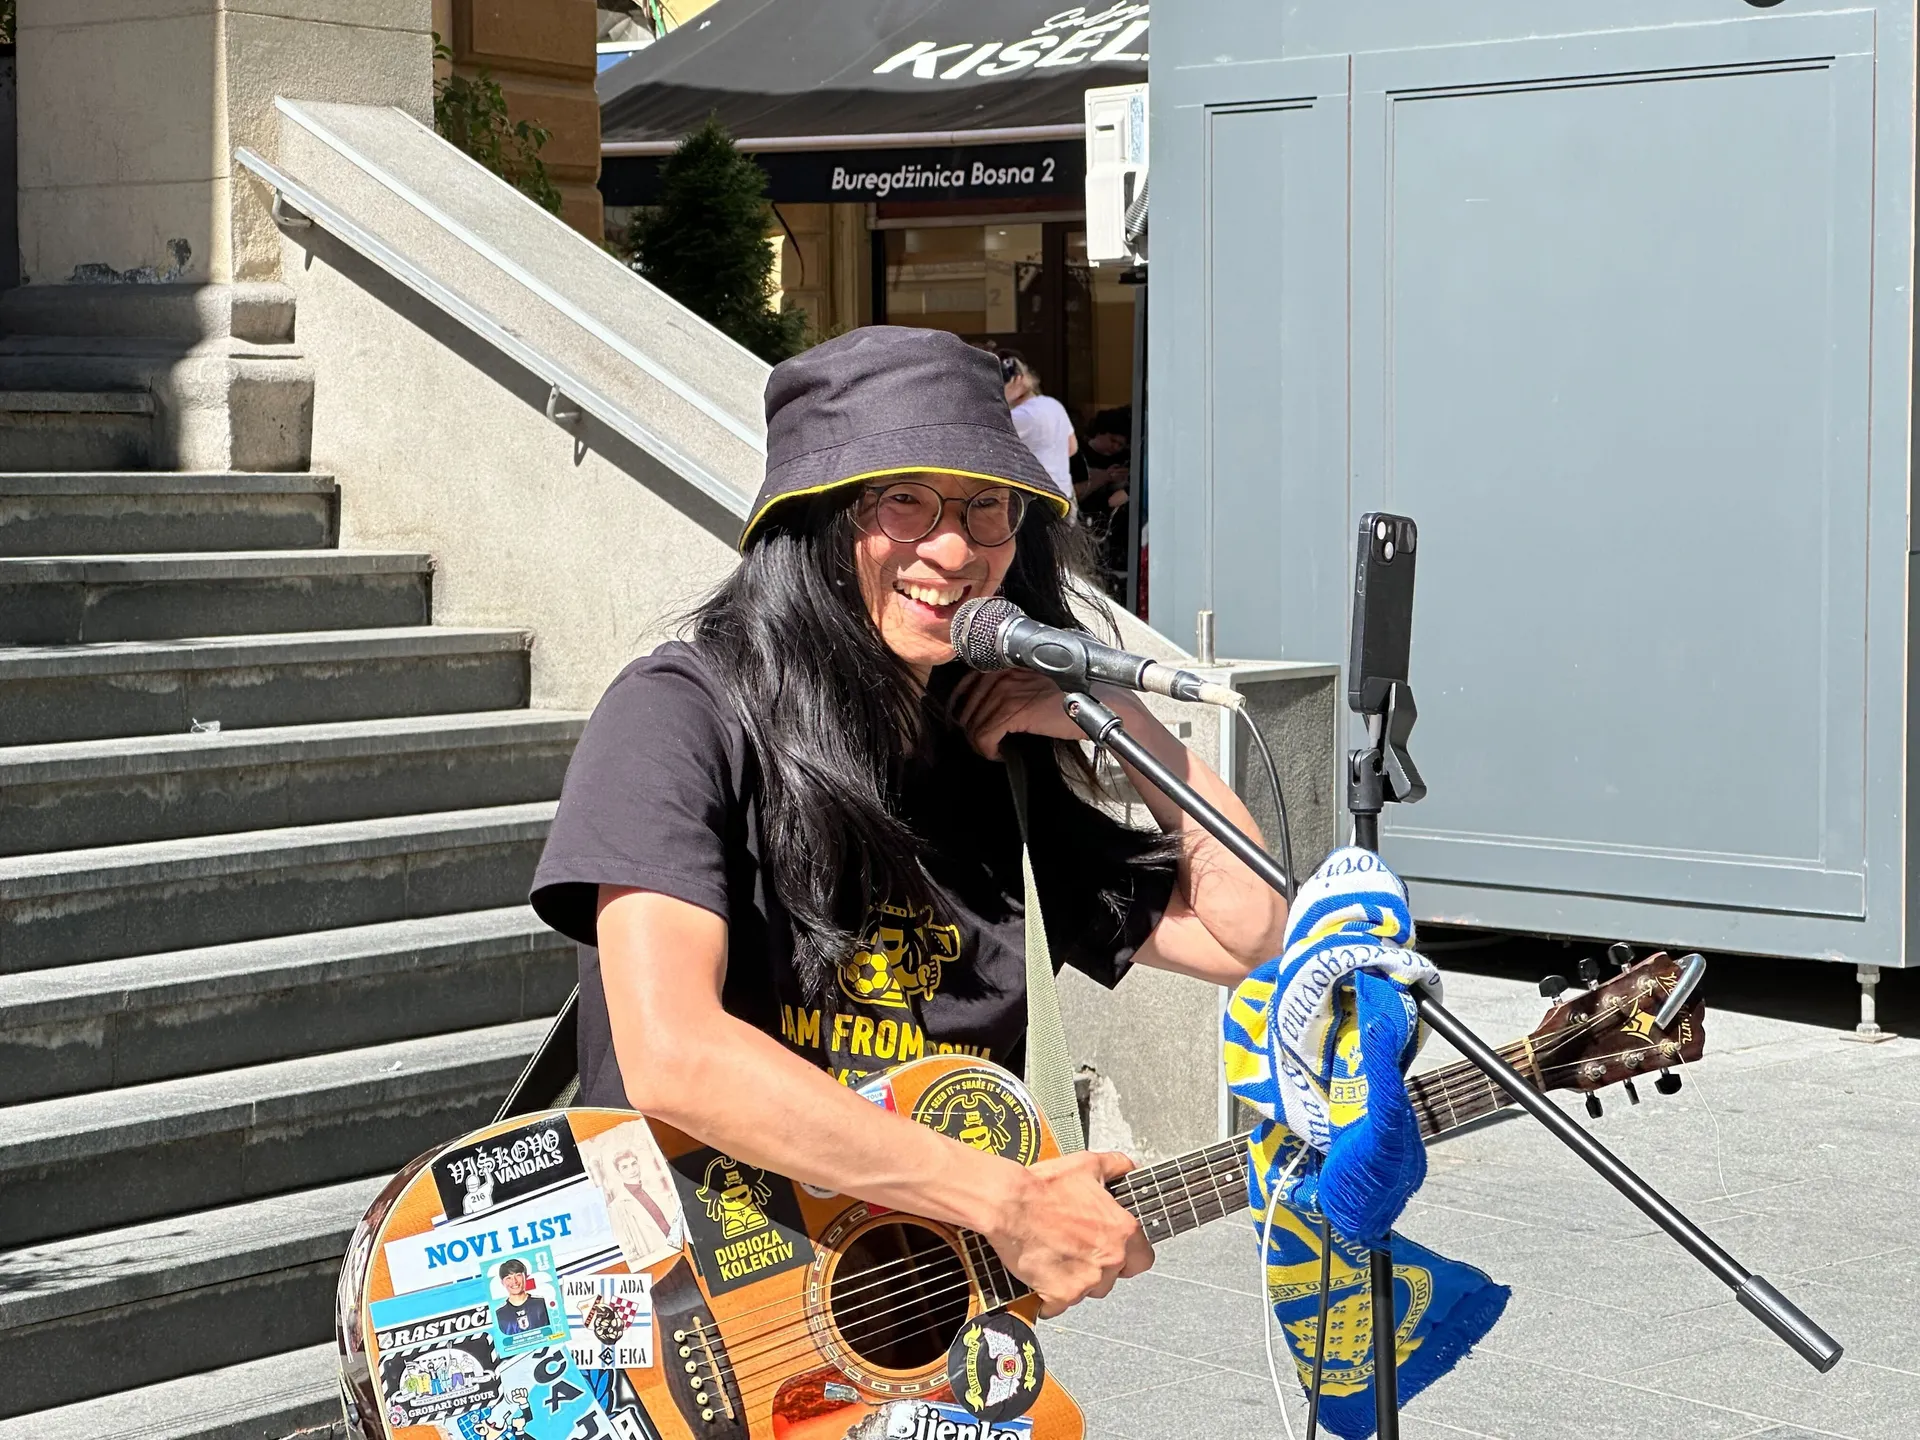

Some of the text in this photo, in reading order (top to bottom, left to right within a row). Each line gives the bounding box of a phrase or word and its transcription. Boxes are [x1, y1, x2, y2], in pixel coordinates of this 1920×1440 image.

[873, 20, 1149, 79] KISEL
[831, 157, 1055, 197] Buregdžinica Bosna 2
[784, 1004, 821, 1049] AM
[831, 1012, 925, 1062] FROM
[931, 1092, 948, 1109] SEED
[945, 1086, 955, 1096] IT
[986, 1082, 994, 1093] IT
[1012, 1103, 1023, 1114] IT
[1018, 1121, 1030, 1155] STREAM
[447, 1129, 559, 1185] VIŠKOVO
[494, 1149, 564, 1185] VANDALS
[1016, 1152, 1026, 1163] IT
[470, 1192, 486, 1204] 216
[424, 1212, 572, 1270] NOVI LIST
[714, 1229, 783, 1266] DUBIOZA
[719, 1241, 794, 1282] KOLEKTIV
[567, 1279, 644, 1296] ARM ADA
[619, 1348, 647, 1364] EKA
[967, 1340, 981, 1395] SILVER WINGS
[408, 1399, 453, 1418] GROBARI
[453, 1396, 468, 1408] ON
[469, 1390, 496, 1403] TOUR
